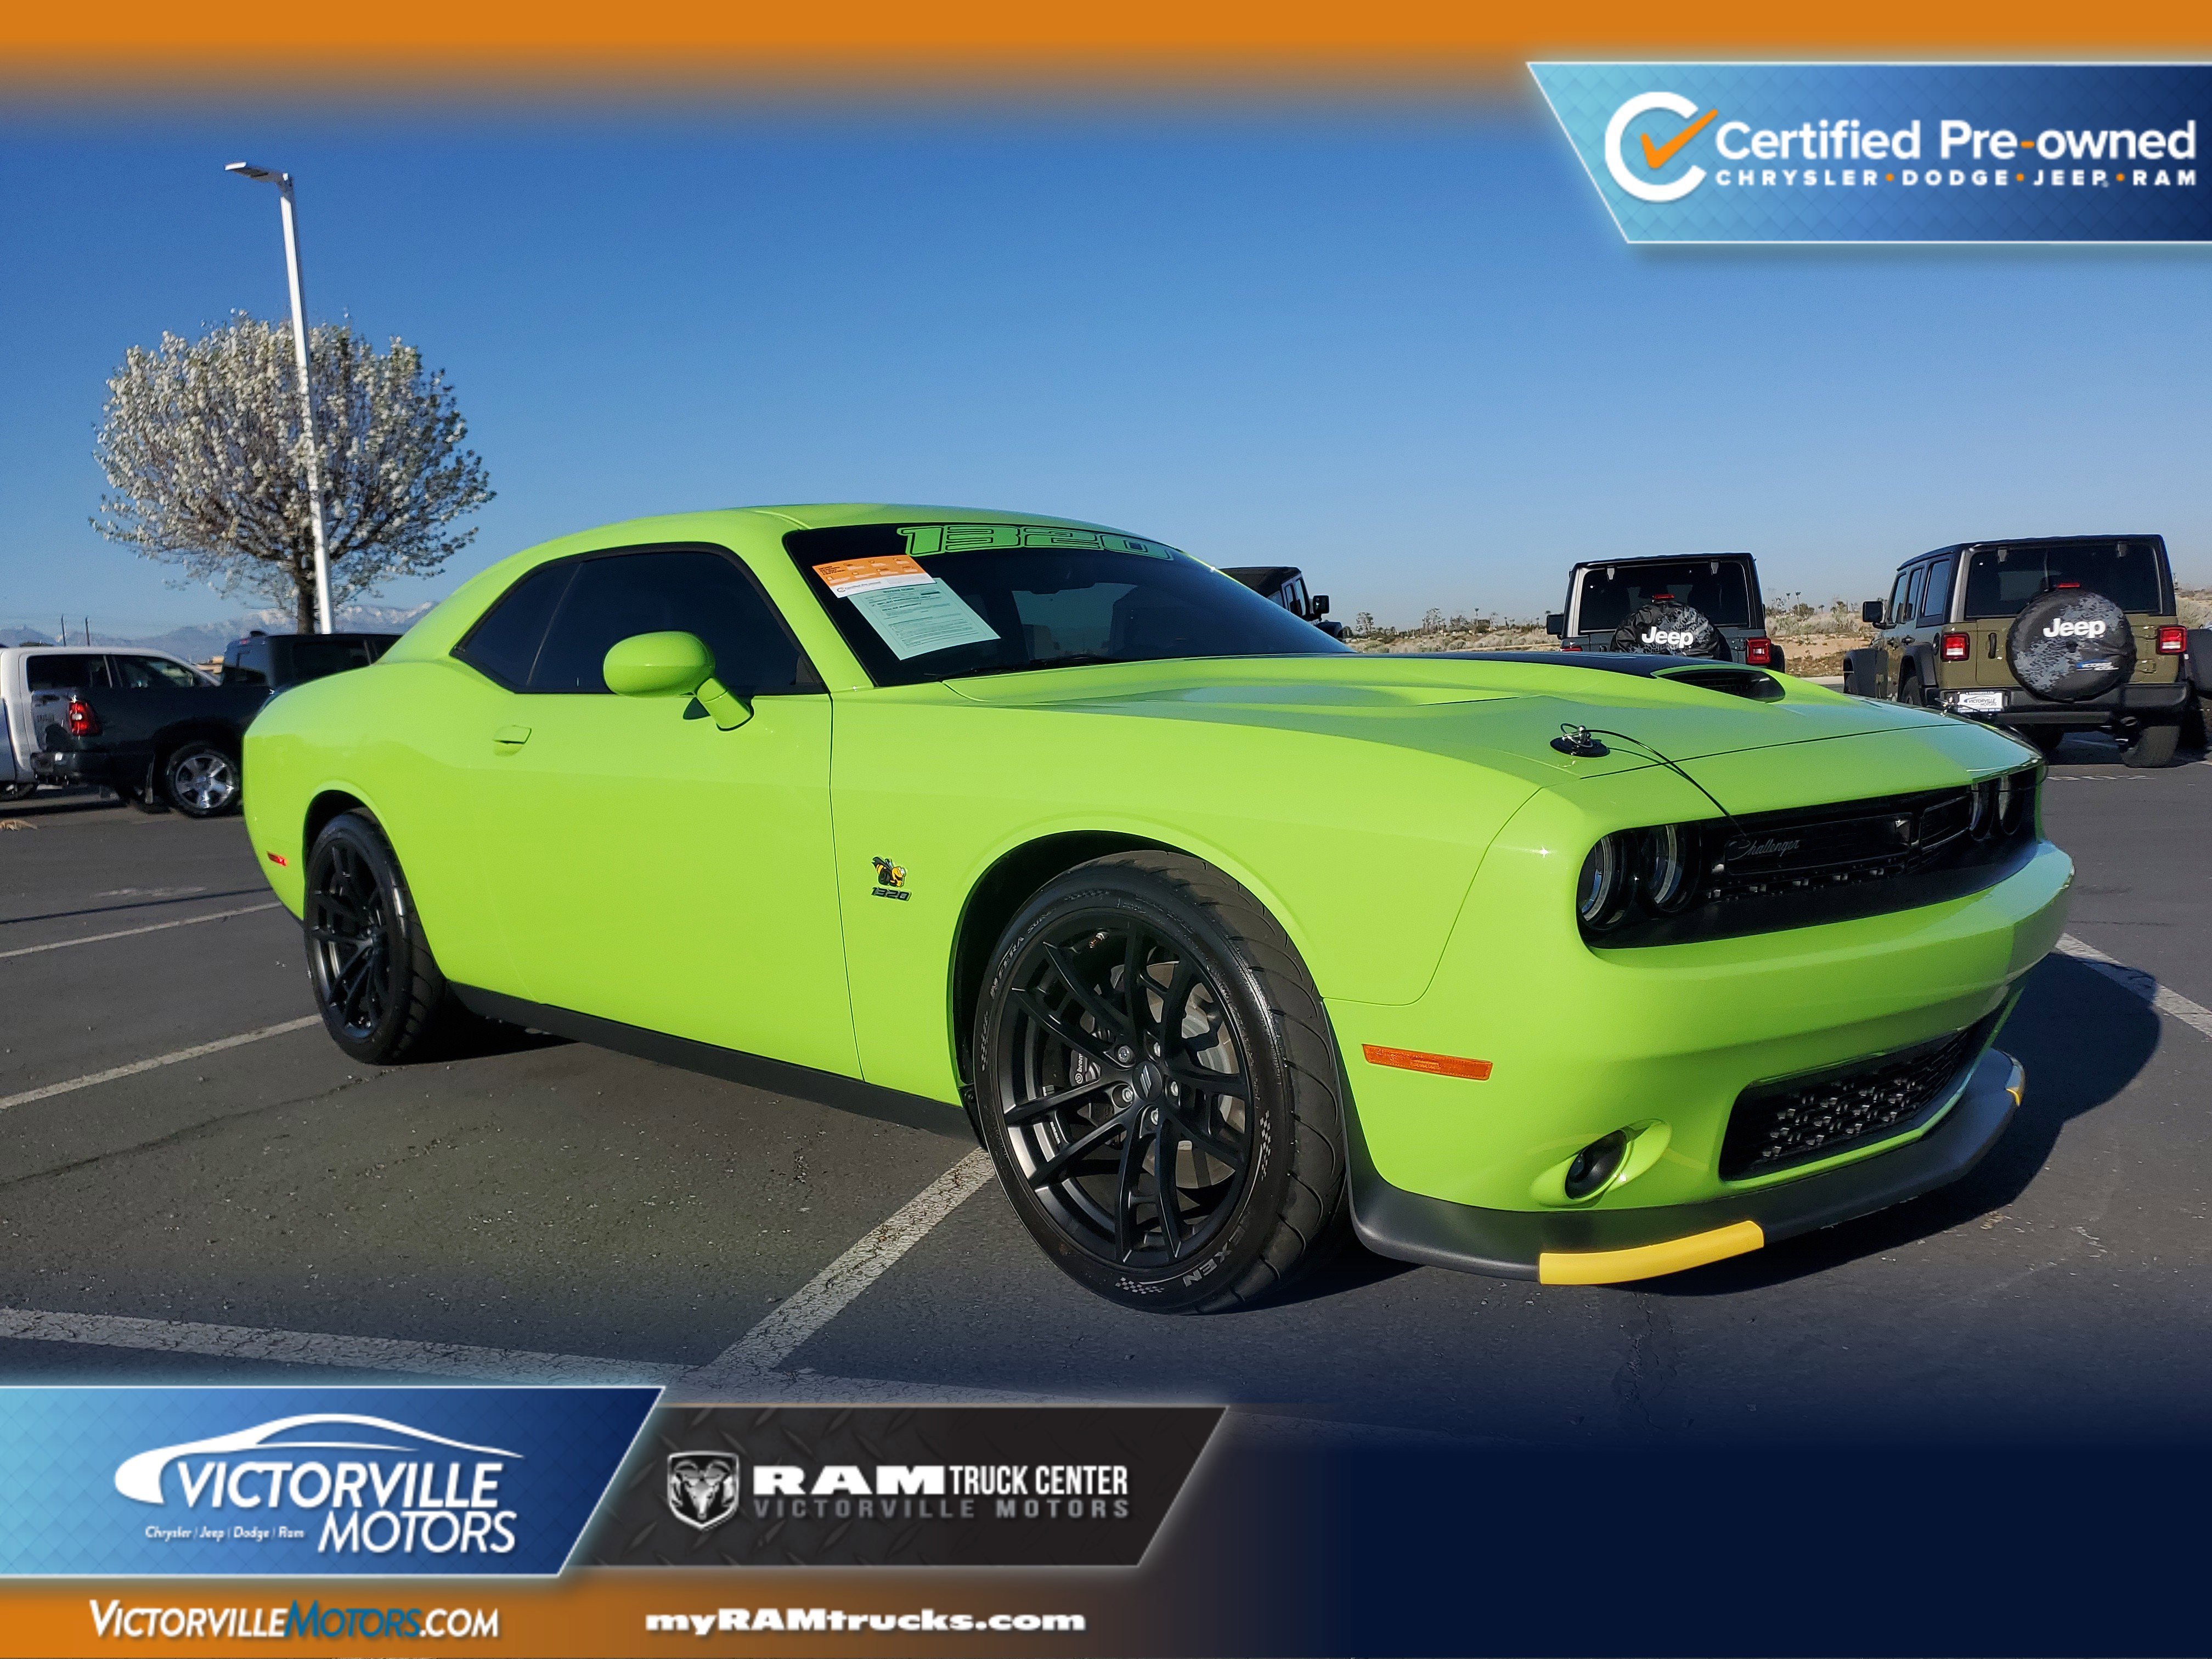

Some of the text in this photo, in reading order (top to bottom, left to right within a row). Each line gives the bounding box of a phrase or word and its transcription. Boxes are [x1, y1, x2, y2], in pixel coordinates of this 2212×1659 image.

[896, 524, 1174, 561] 1320
[1641, 626, 1694, 648] Jeep
[2043, 618, 2106, 639] Jeep
[1728, 838, 1800, 860] Challenger
[871, 887, 912, 901] 1320
